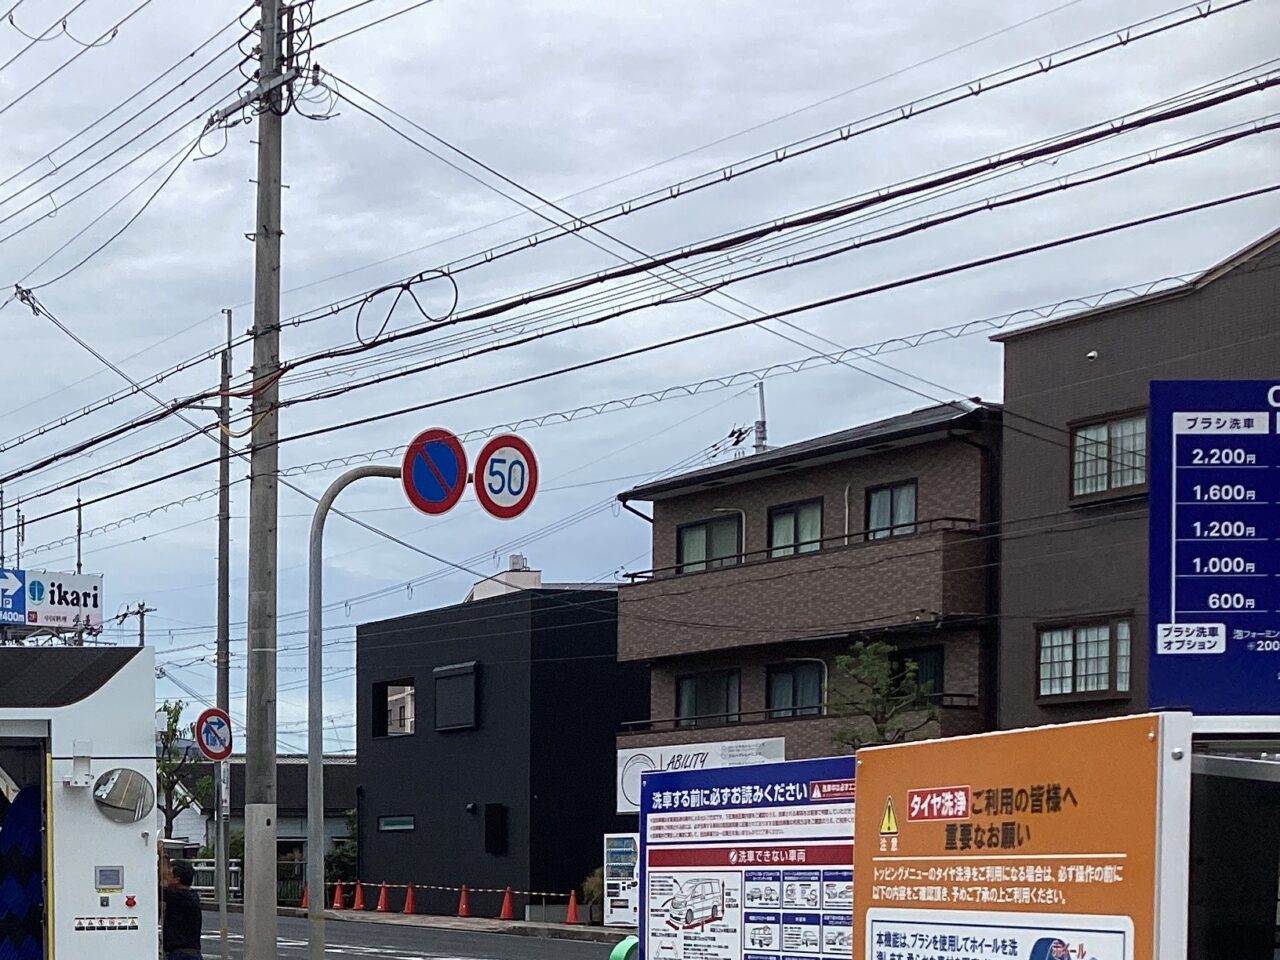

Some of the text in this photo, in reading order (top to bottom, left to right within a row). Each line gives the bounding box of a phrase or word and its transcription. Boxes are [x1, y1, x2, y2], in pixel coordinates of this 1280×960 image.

[1186, 417, 1255, 430] ブラシ洗車
[1192, 449, 1256, 465] 2,200円
[488, 458, 525, 496] 50
[1193, 485, 1256, 501] 1,600円
[1193, 521, 1256, 537] 1,200円
[1193, 557, 1256, 573] 1,000円
[49, 582, 99, 608] ikari
[1208, 594, 1256, 609] 600円
[1162, 627, 1219, 638] ブラシ洗車
[1163, 640, 1218, 651] オプション
[667, 752, 709, 770] ABILITY
[652, 783, 807, 810] 洗車する前に必ずお読みください
[910, 783, 1078, 817] タイヤ洗浄 ご利用の皆様へ
[945, 822, 1031, 850] 重要なお願い
[738, 849, 806, 863] 洗車できない車両
[1051, 939, 1086, 960] ホイール
